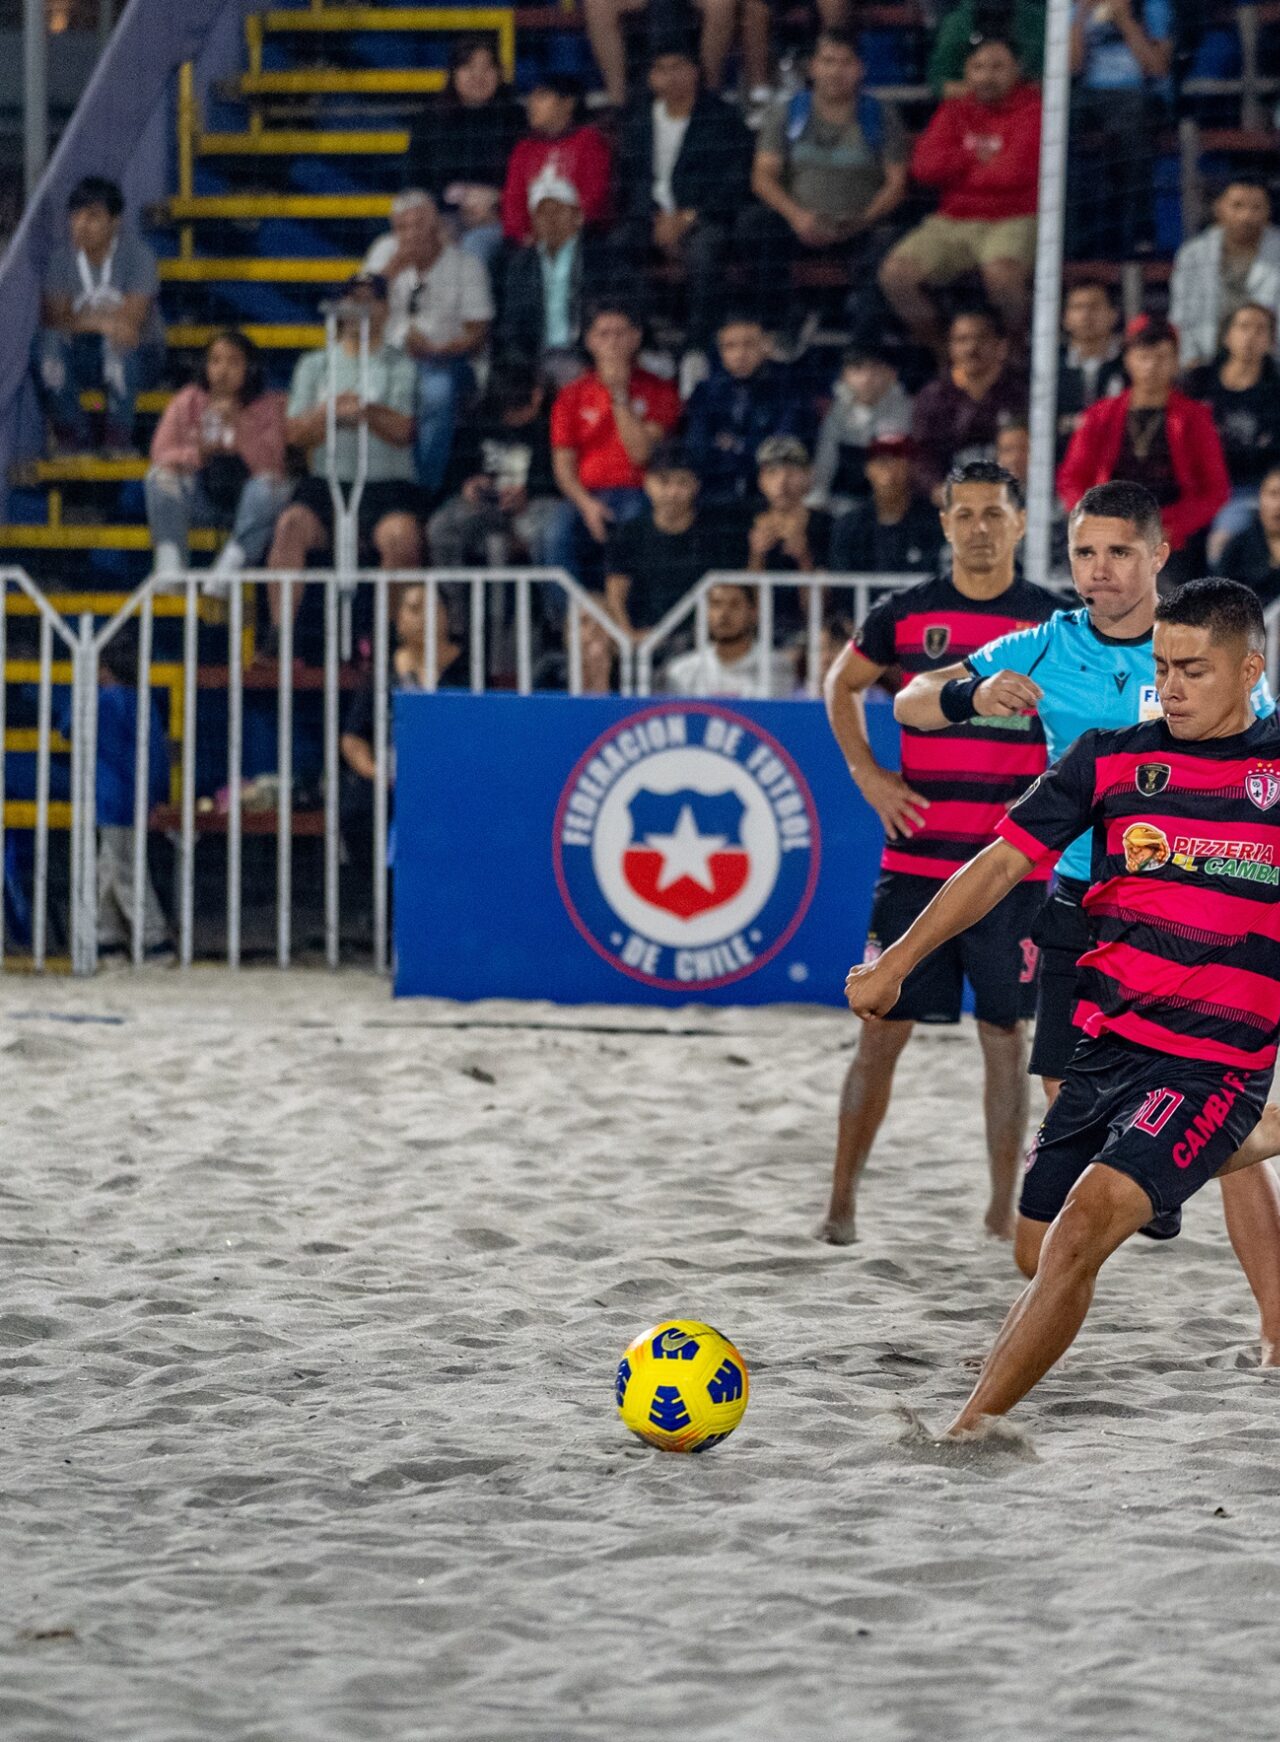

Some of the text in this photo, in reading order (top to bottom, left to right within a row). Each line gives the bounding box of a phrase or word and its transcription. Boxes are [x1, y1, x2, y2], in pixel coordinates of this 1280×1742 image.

[704, 716, 745, 757] DE
[746, 743, 812, 853] FUTBOL
[1171, 853, 1280, 886] EL CAMBA
[1173, 836, 1275, 865] PIZZERIA
[621, 934, 756, 982] DE CHILE
